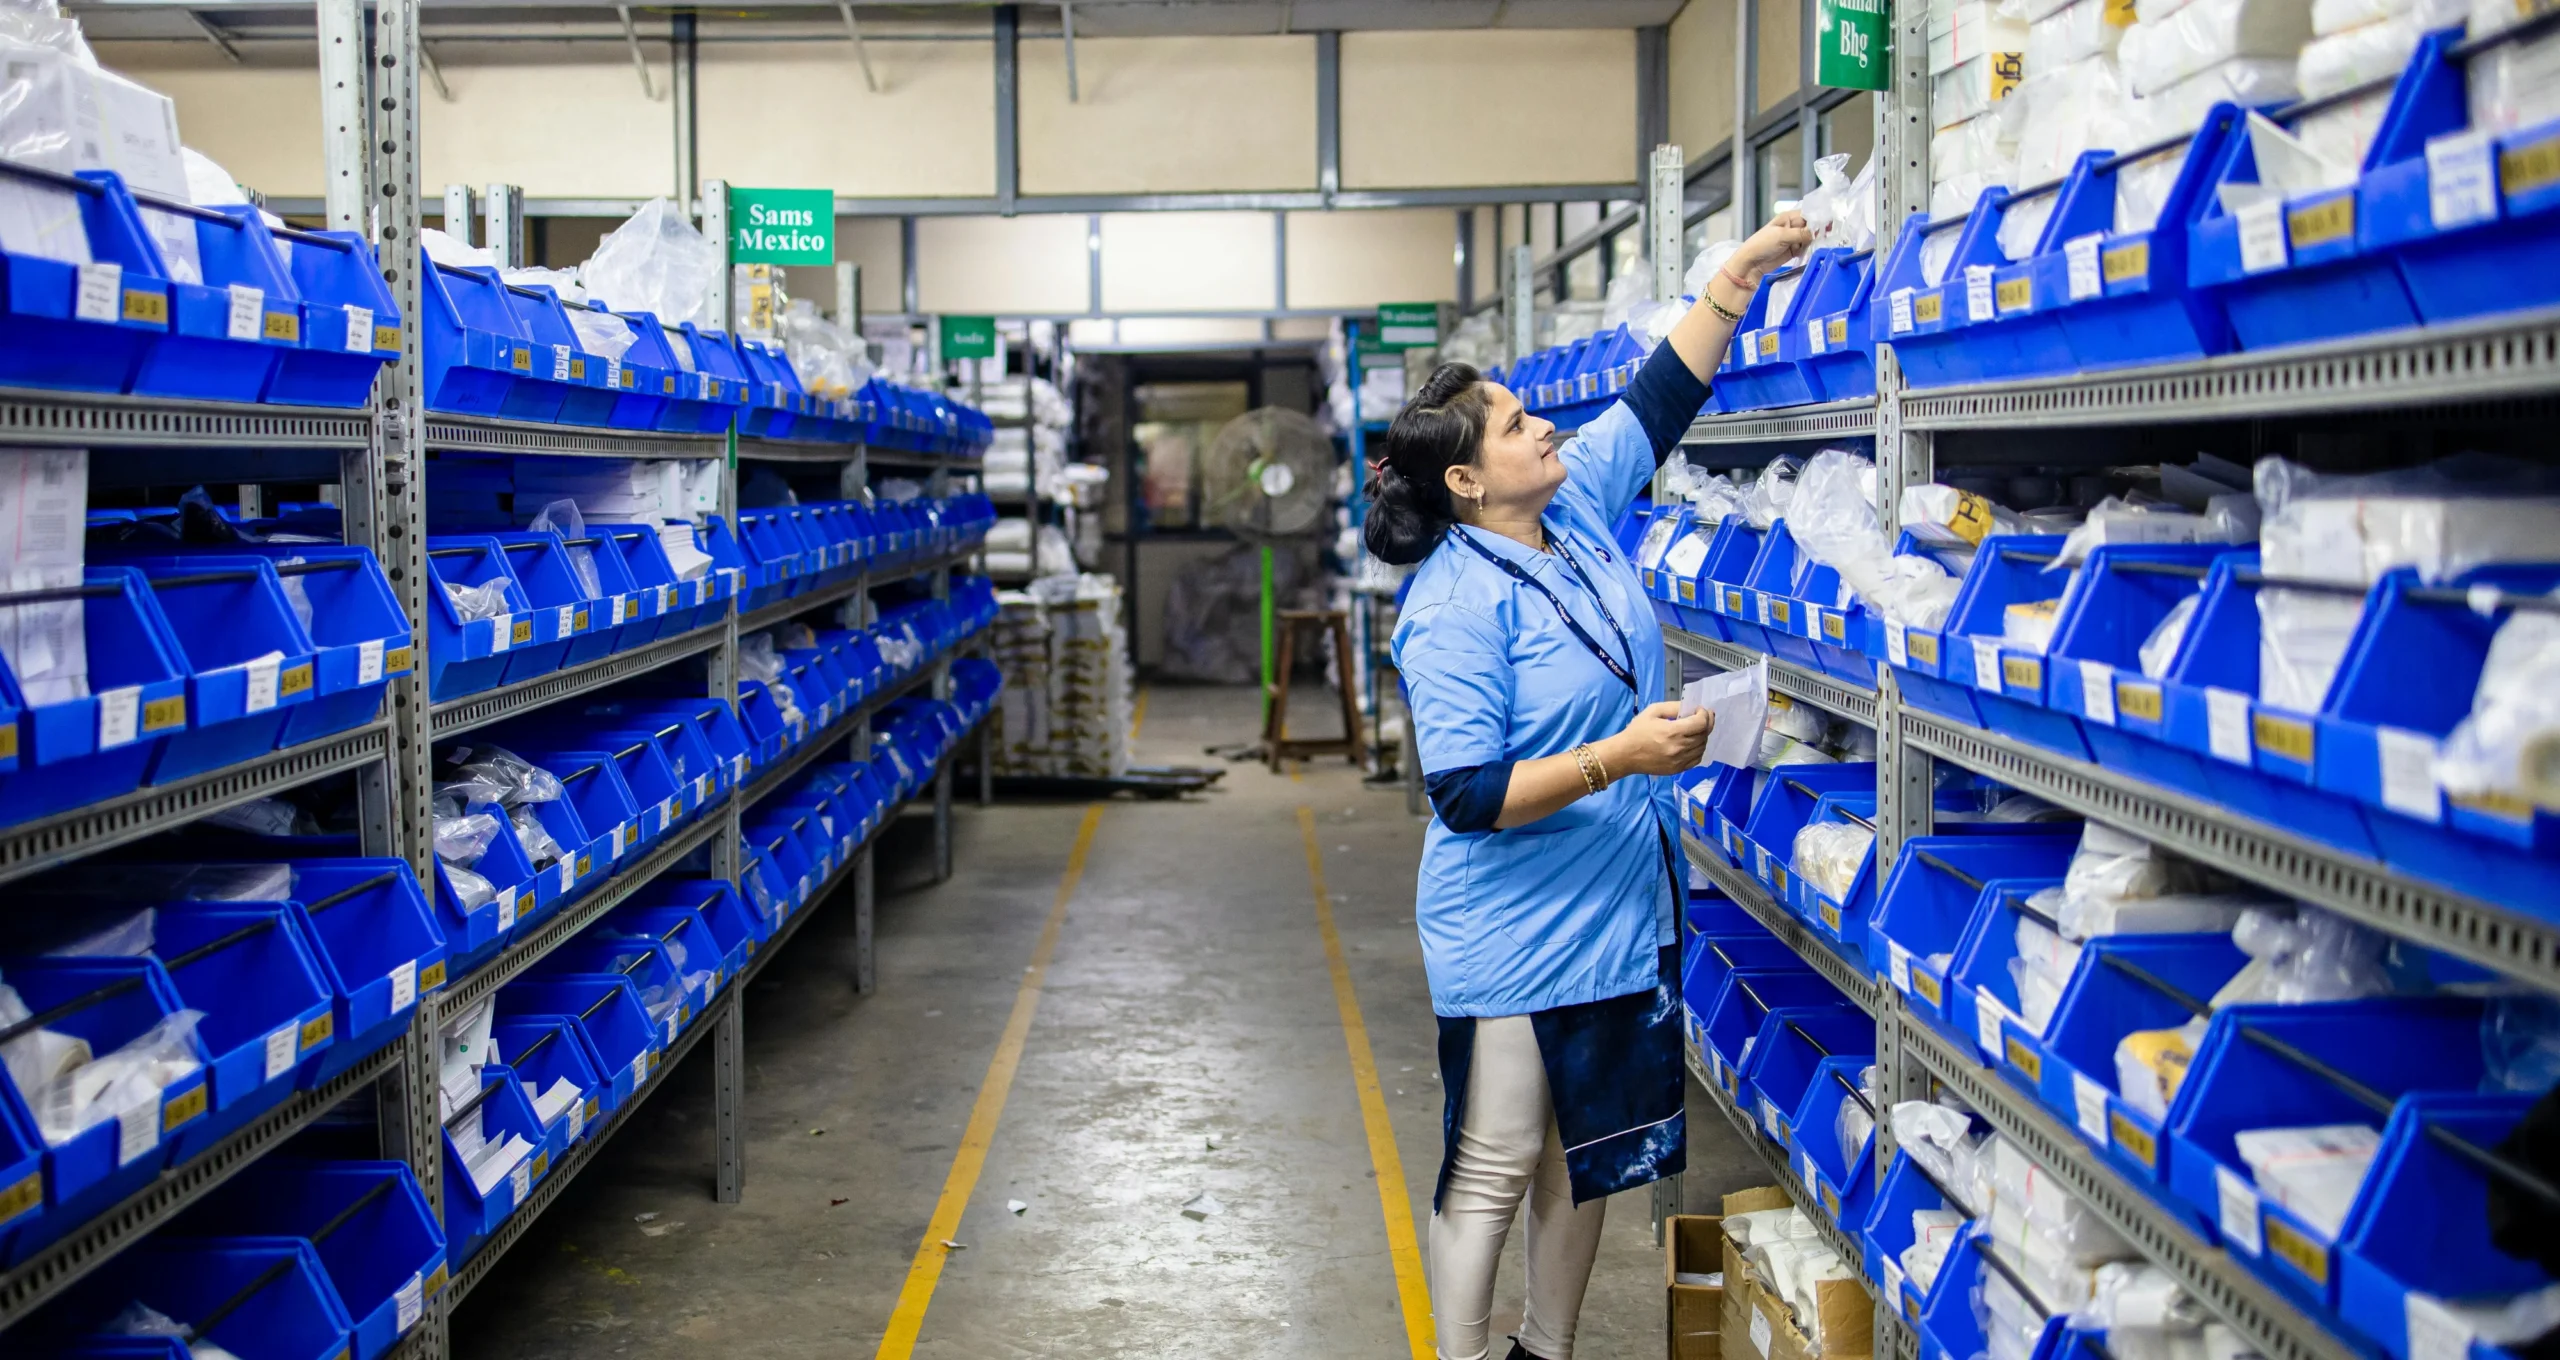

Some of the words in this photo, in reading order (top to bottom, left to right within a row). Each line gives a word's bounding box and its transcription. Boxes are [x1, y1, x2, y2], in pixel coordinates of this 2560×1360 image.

[1840, 20, 1868, 68] Bhg
[749, 203, 813, 226] Sams
[738, 228, 825, 251] Mexico
